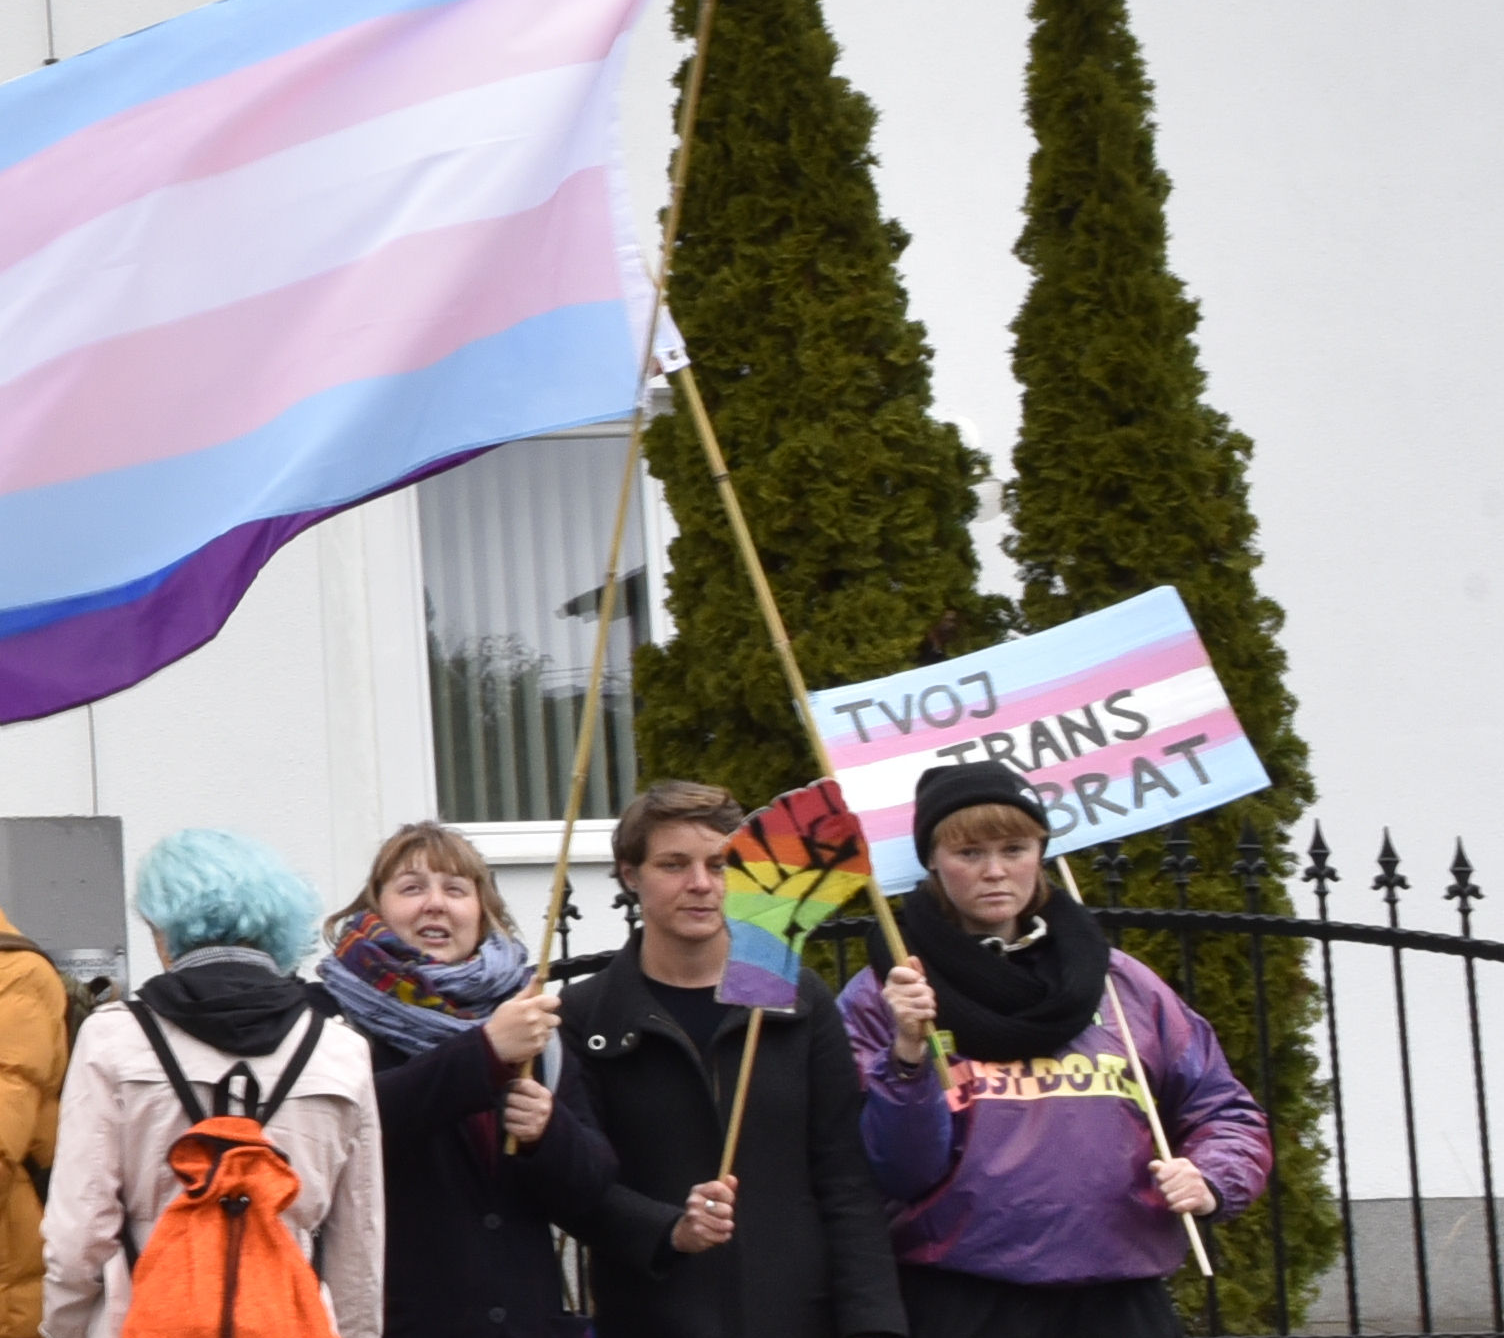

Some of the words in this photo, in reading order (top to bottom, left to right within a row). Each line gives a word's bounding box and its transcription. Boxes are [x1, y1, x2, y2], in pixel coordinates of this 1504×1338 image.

[833, 670, 998, 743] TVOJ
[937, 688, 1151, 773] TRANS
[1031, 734, 1209, 839] BRAT
